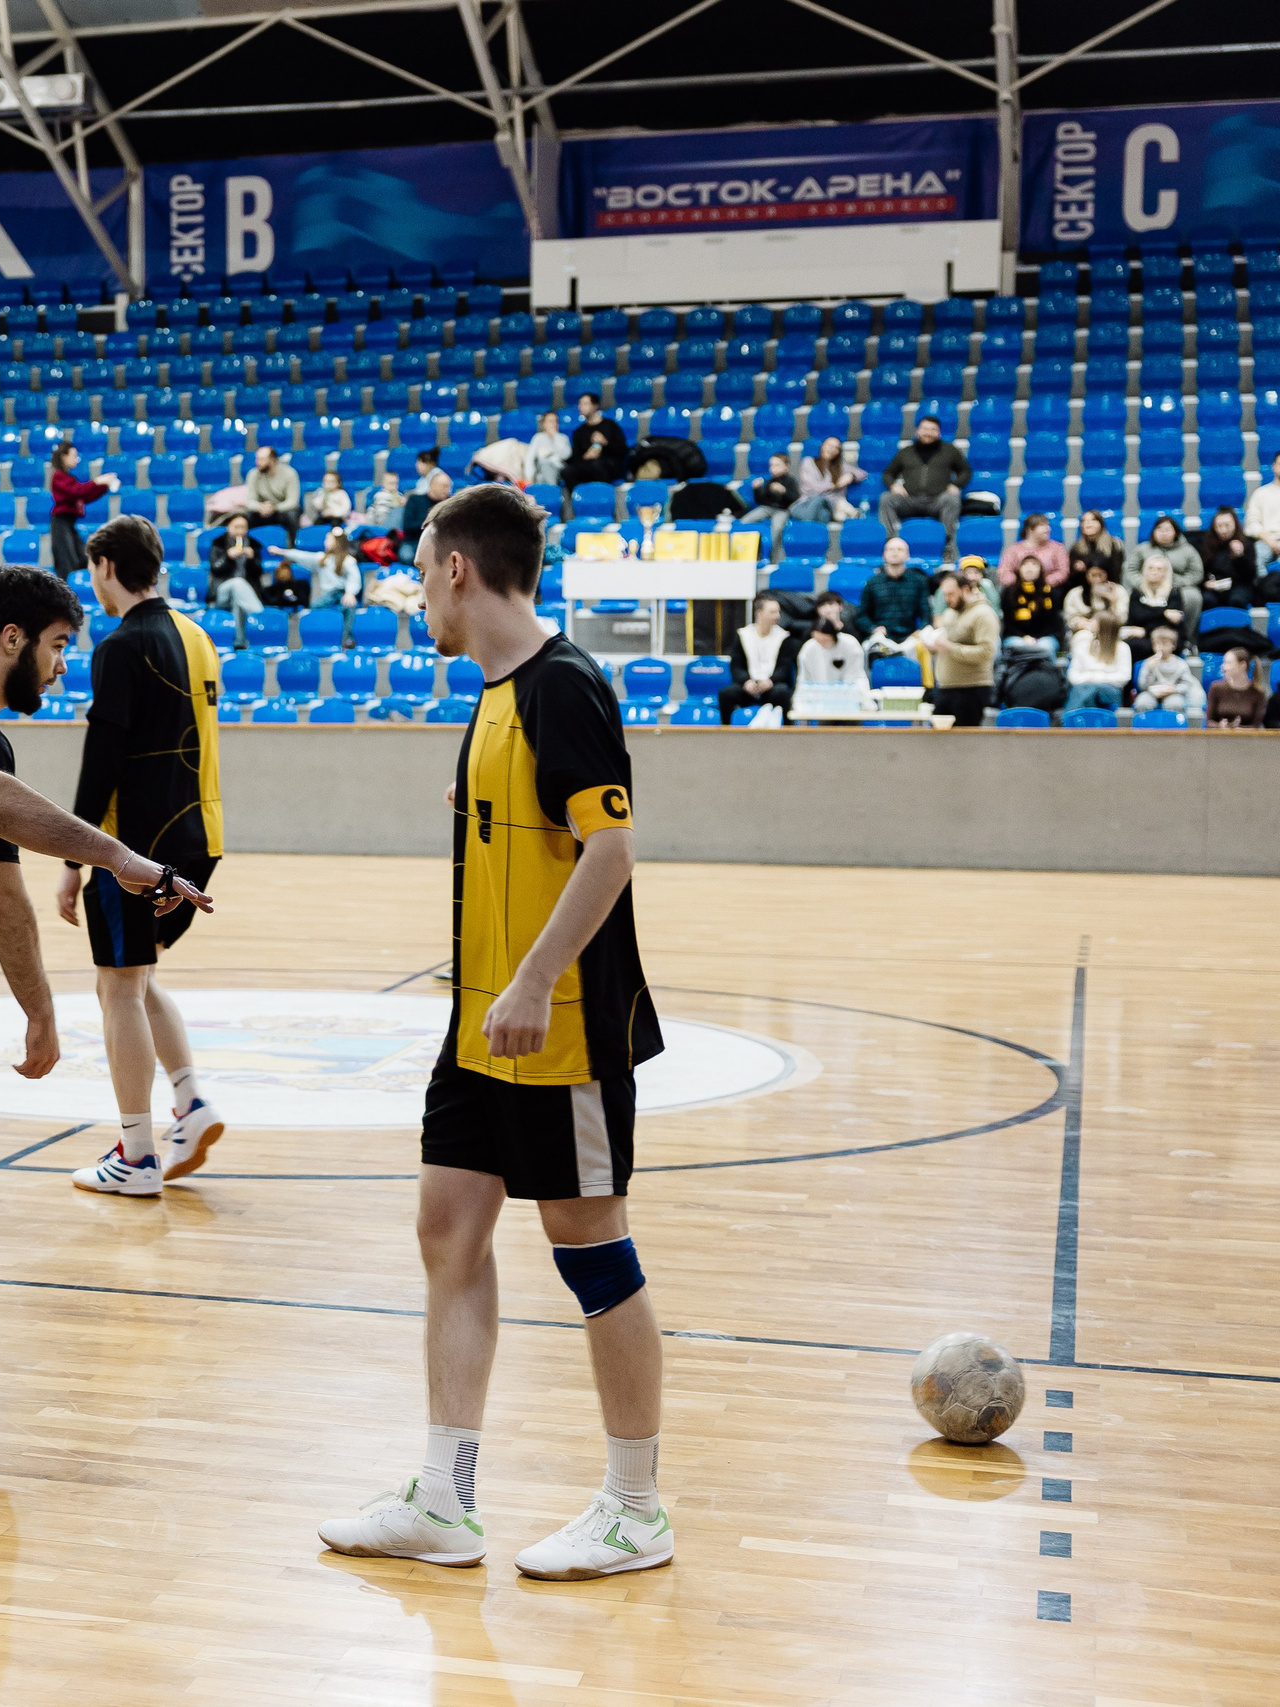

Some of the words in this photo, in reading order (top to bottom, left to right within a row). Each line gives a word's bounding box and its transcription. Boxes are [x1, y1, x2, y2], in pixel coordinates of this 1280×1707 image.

[226, 175, 275, 277] B
[1052, 120, 1097, 241] СЕКТОР
[1122, 122, 1180, 233] C
[601, 788, 628, 820] C
